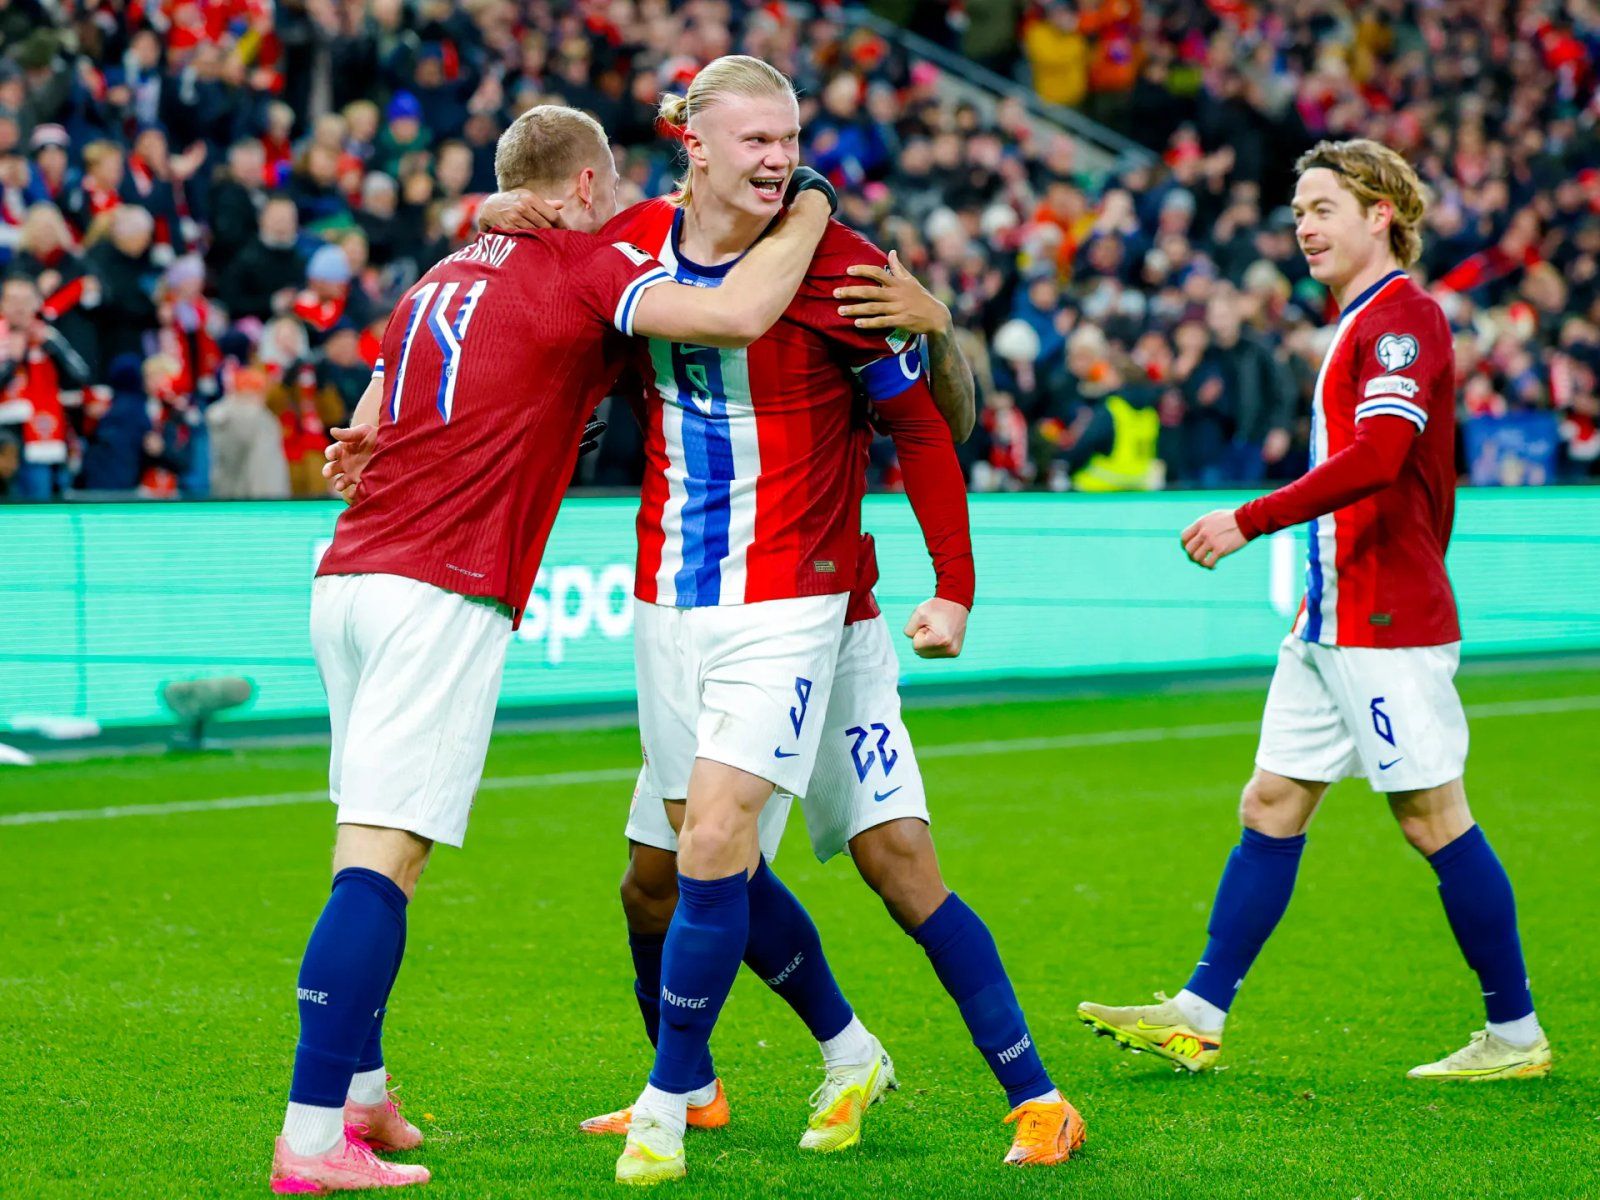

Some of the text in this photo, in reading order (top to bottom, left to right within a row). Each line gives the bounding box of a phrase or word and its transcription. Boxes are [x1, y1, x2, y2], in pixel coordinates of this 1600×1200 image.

[429, 233, 518, 268] ERSON
[389, 279, 488, 425] 14
[899, 350, 921, 381] C
[789, 676, 813, 740] 9
[1370, 696, 1396, 748] 6
[845, 722, 898, 785] 22
[297, 987, 329, 1006] ORGE
[661, 984, 709, 1010] NORGE
